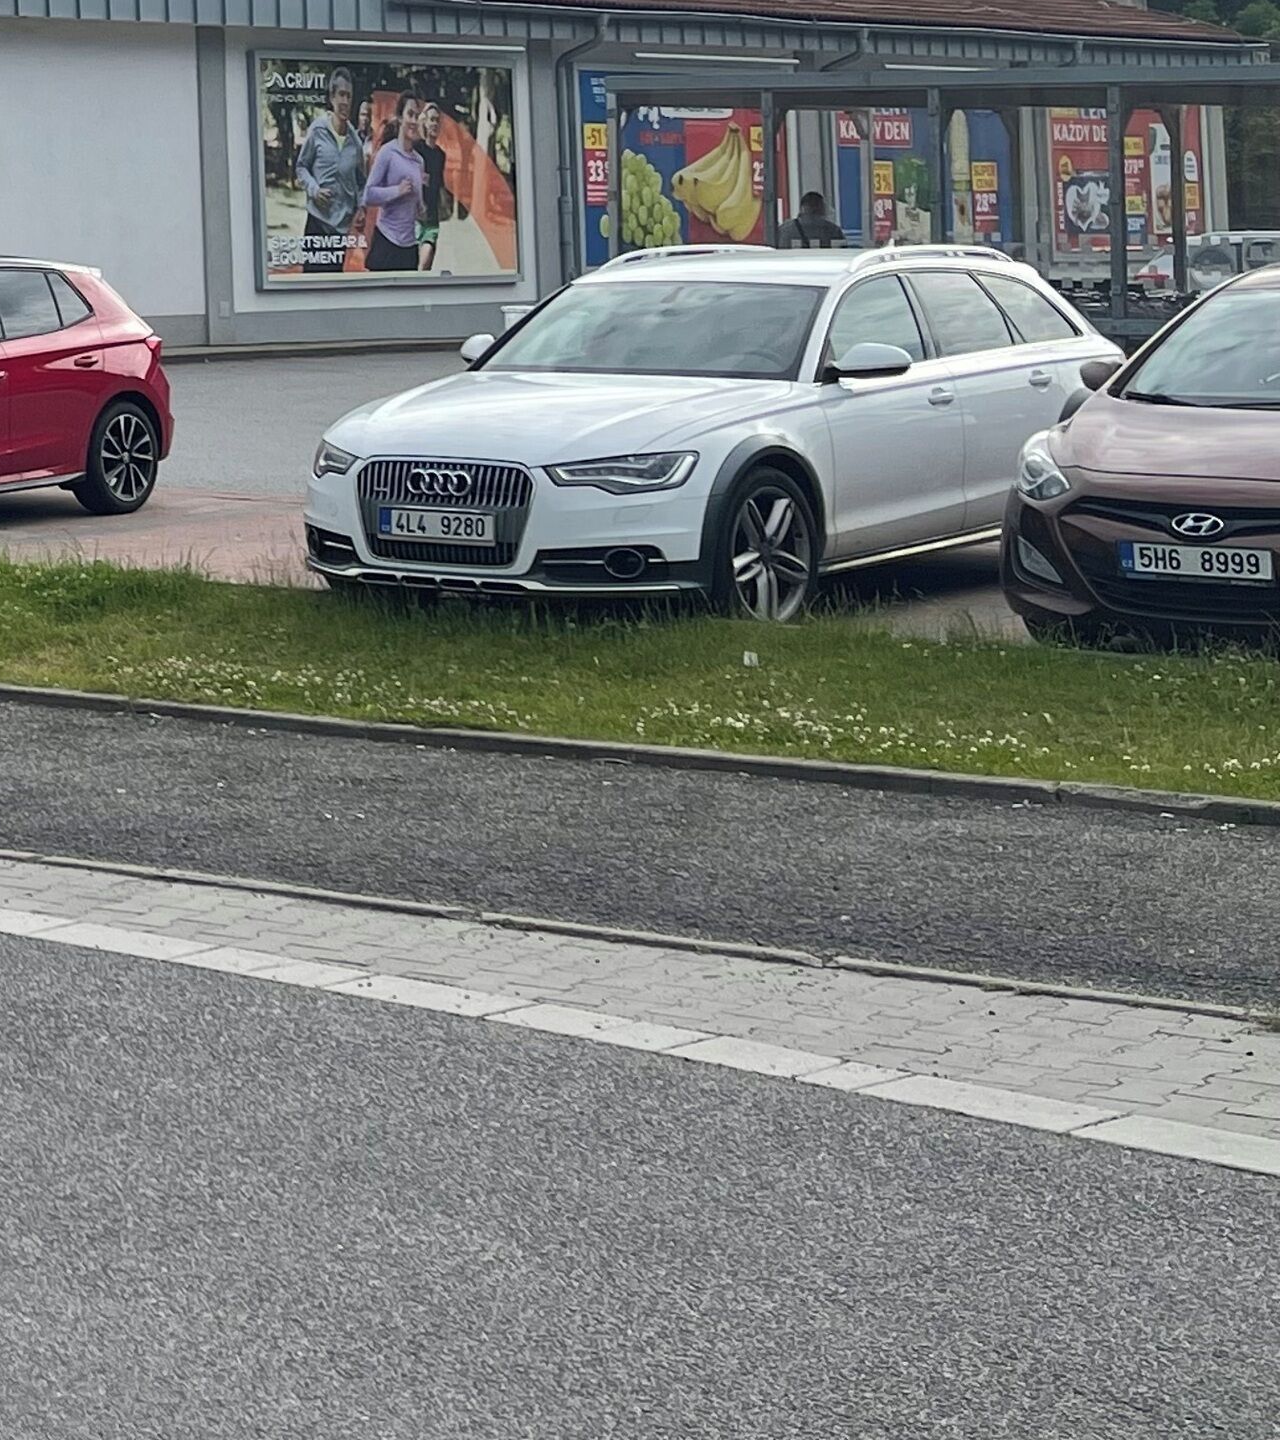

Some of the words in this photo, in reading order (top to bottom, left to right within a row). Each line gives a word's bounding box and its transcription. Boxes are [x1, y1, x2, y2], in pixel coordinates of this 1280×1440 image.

[285, 72, 326, 89] CRIVIT
[884, 121, 910, 141] DEN
[1092, 124, 1107, 143] DE
[270, 235, 357, 249] SPORTSWEAR
[358, 235, 368, 248] &
[271, 250, 345, 265] EQUIPMENT
[395, 512, 427, 534] 4L4
[441, 515, 485, 538] 9280
[1138, 546, 1182, 570] 5H6
[1200, 550, 1261, 575] 8999
